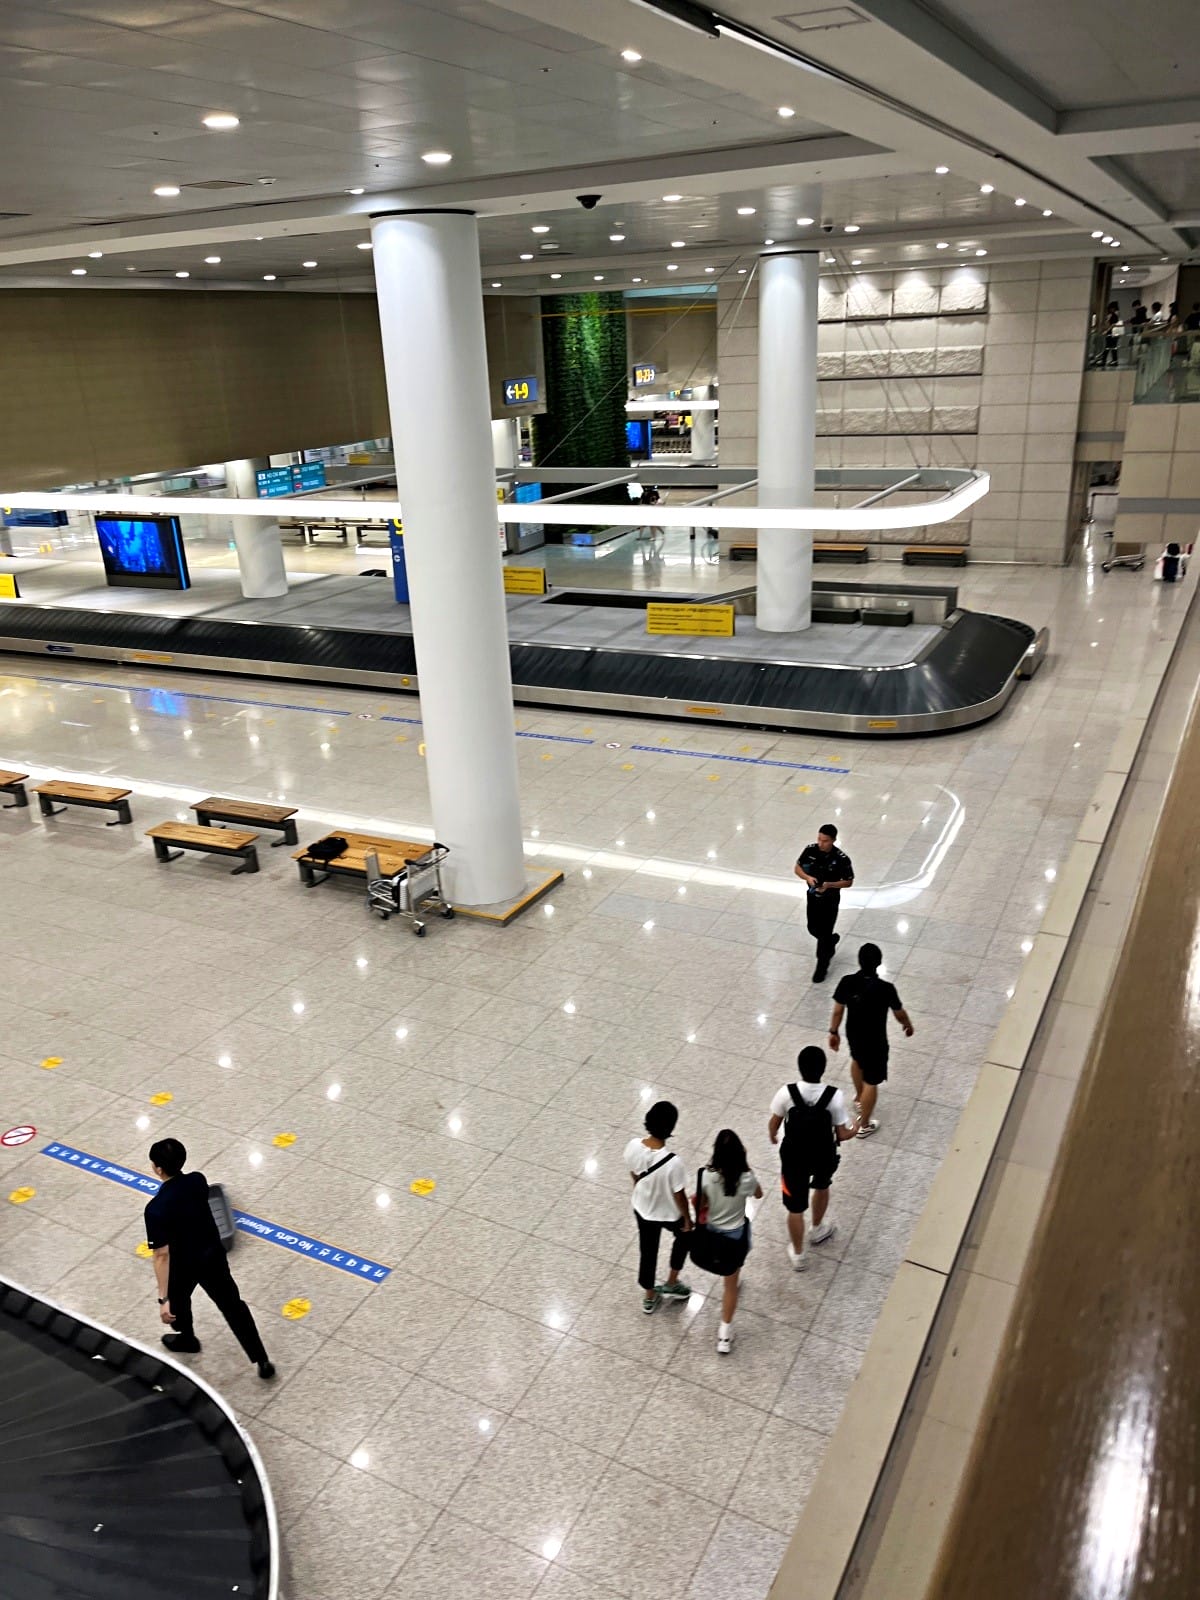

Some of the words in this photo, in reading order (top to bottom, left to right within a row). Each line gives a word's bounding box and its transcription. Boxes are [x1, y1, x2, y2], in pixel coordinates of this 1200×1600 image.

[514, 382, 529, 400] 1-9
[236, 1217, 274, 1235] Allowed
[275, 1231, 298, 1245] Carts
[298, 1240, 315, 1251] No
